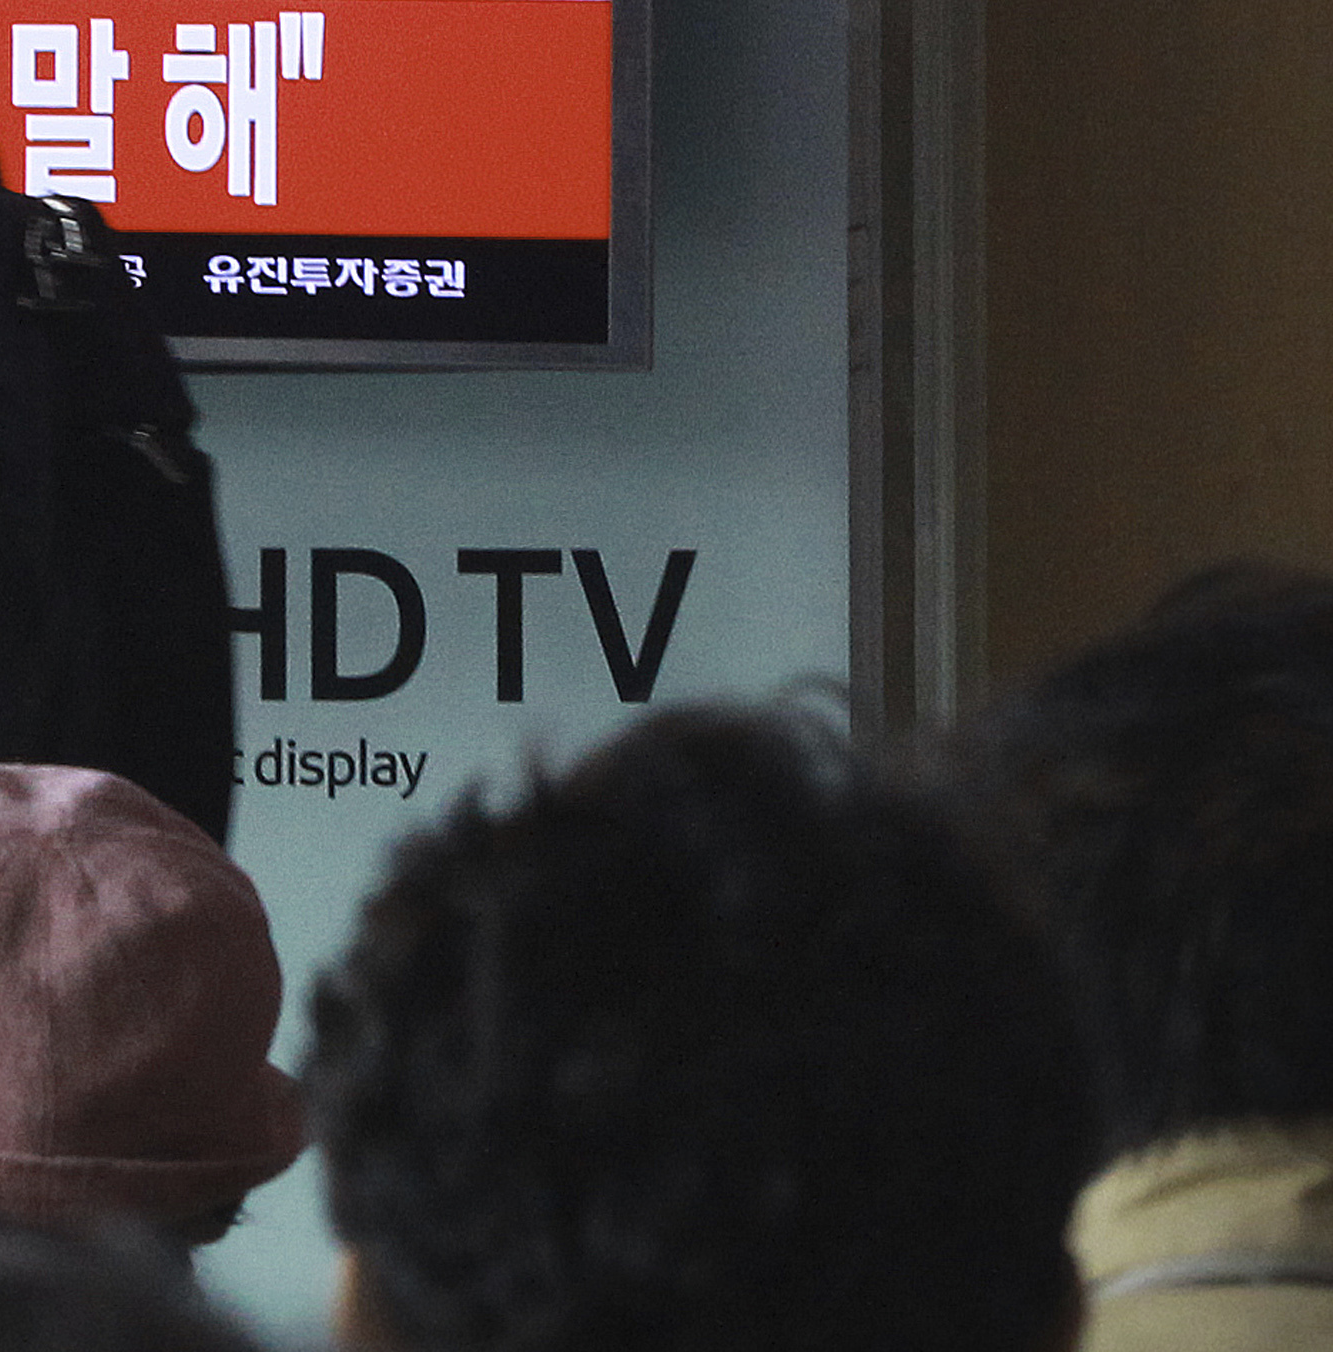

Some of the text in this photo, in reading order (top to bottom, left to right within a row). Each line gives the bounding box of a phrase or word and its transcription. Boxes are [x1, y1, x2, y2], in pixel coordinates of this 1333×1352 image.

[10, 16, 131, 204] 말
[202, 253, 466, 299] 유진투자증권
[455, 548, 698, 705] TV
[254, 736, 429, 800] display
